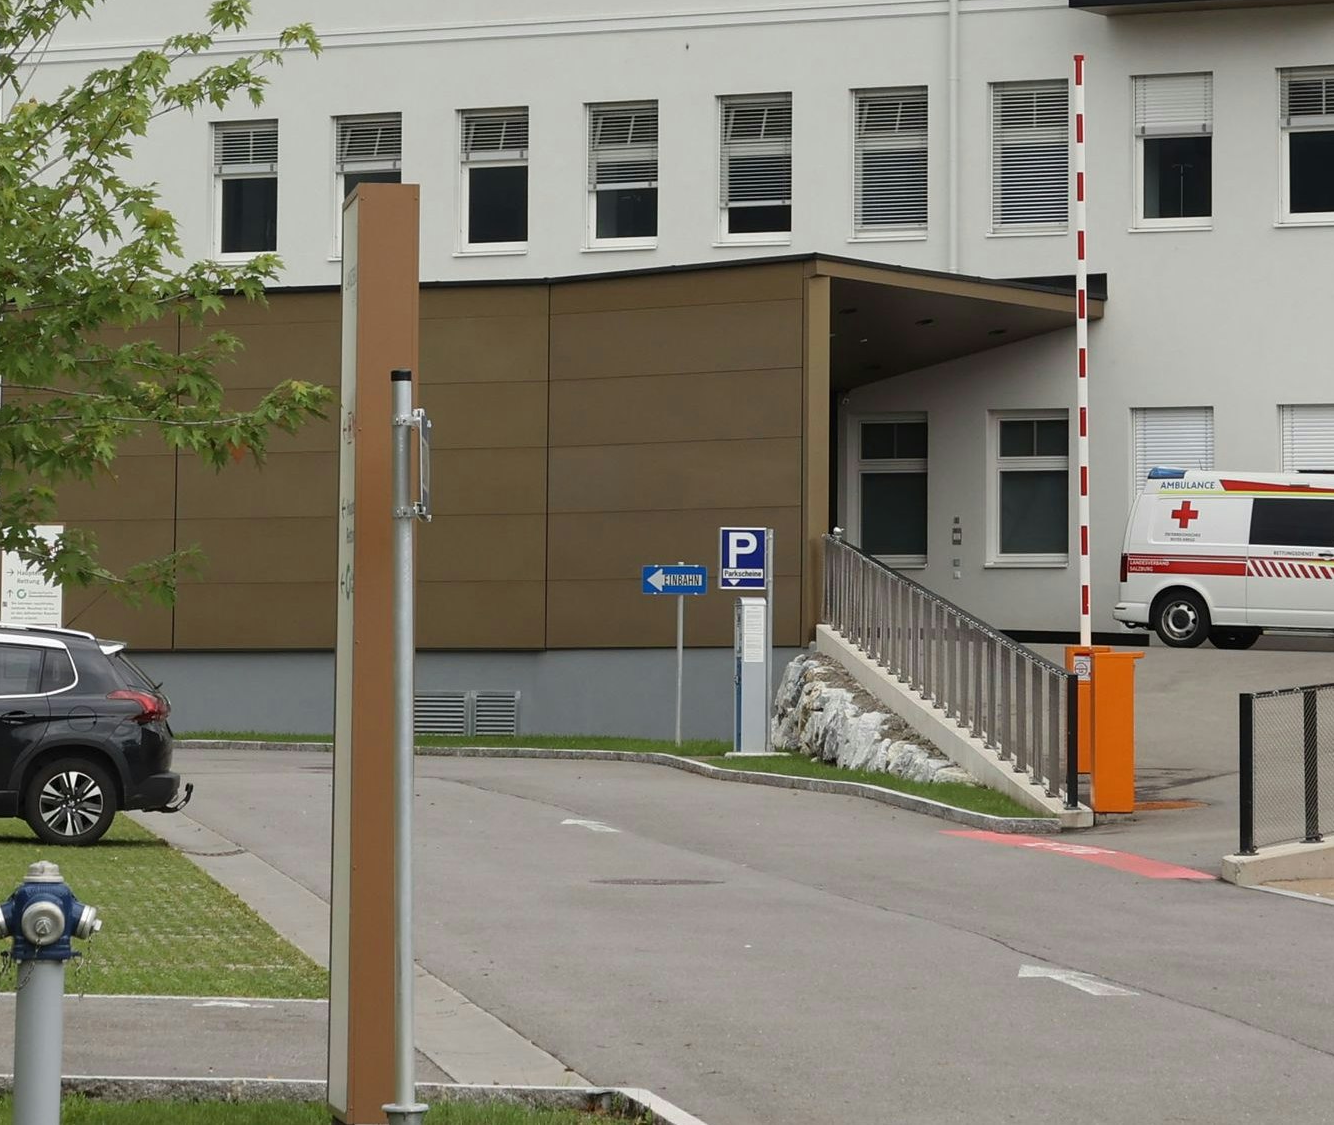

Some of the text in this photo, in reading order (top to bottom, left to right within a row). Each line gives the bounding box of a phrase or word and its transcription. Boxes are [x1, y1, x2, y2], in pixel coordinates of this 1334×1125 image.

[1160, 481, 1216, 490] AMBULANCE
[728, 531, 758, 568] P
[724, 569, 762, 578] Parkscheine
[664, 574, 700, 586] EINBAHN
